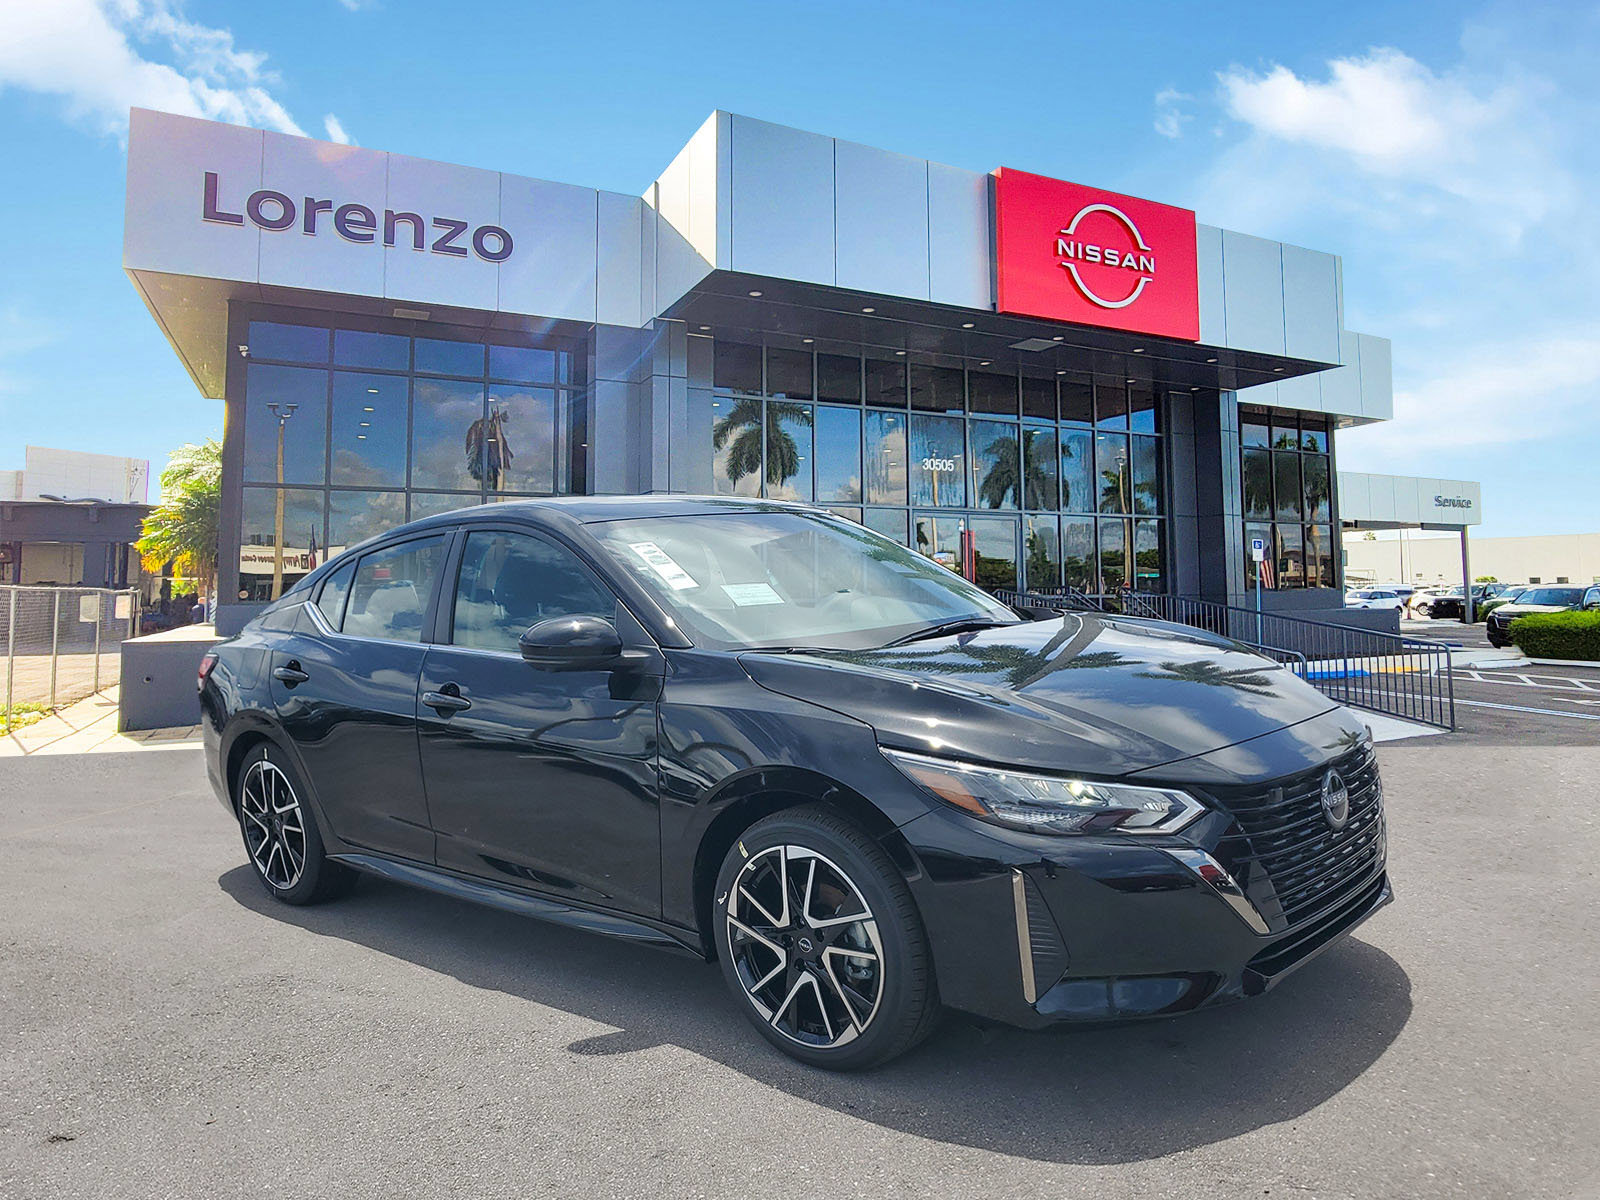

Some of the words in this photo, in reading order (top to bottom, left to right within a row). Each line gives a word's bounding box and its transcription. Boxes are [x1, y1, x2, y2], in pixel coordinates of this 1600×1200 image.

[202, 171, 514, 262] Lorenzo
[1057, 238, 1155, 273] NISSAN
[922, 457, 955, 472] 30505
[1434, 495, 1472, 509] Service
